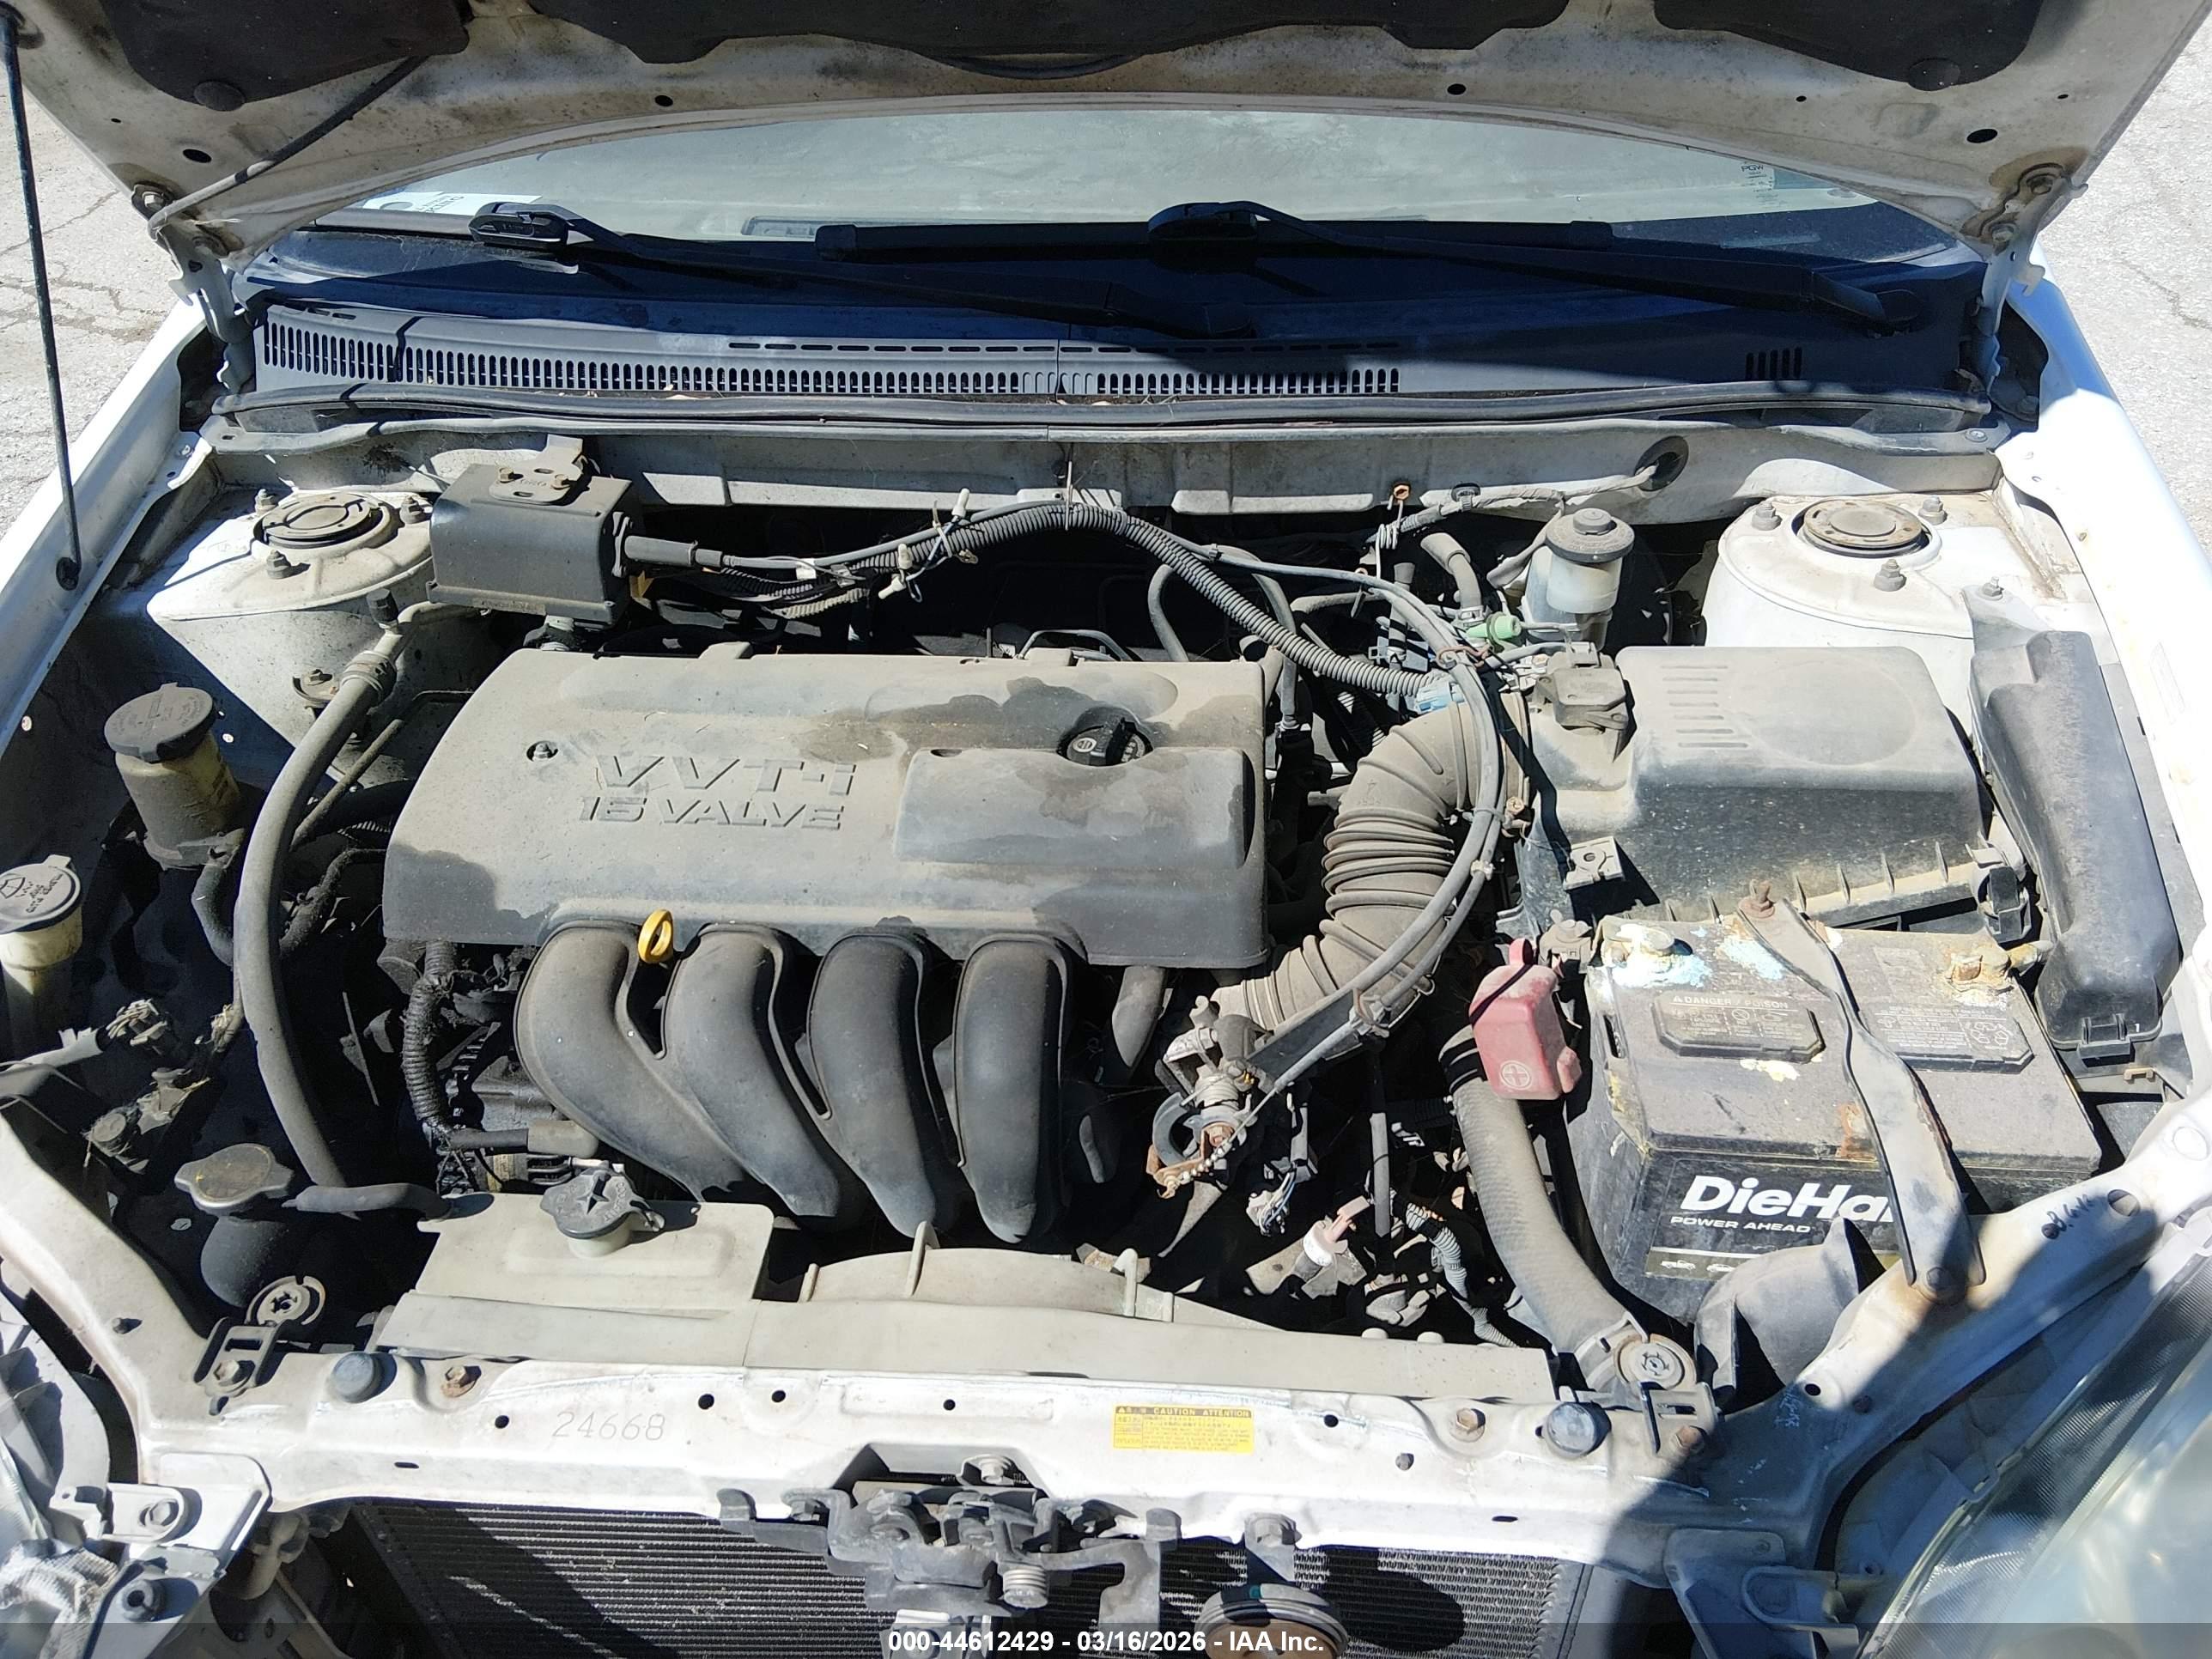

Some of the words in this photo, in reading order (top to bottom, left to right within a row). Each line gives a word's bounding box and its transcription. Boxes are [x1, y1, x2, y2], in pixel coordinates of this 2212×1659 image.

[579, 796, 648, 823] 16
[657, 799, 846, 830] VALVE
[1685, 996, 1732, 1006] DANGER
[1744, 1000, 1789, 1009] POISON
[1670, 1216, 1738, 1229] POWER
[1743, 1222, 1811, 1233] AHEAD
[551, 1411, 666, 1441] 24668
